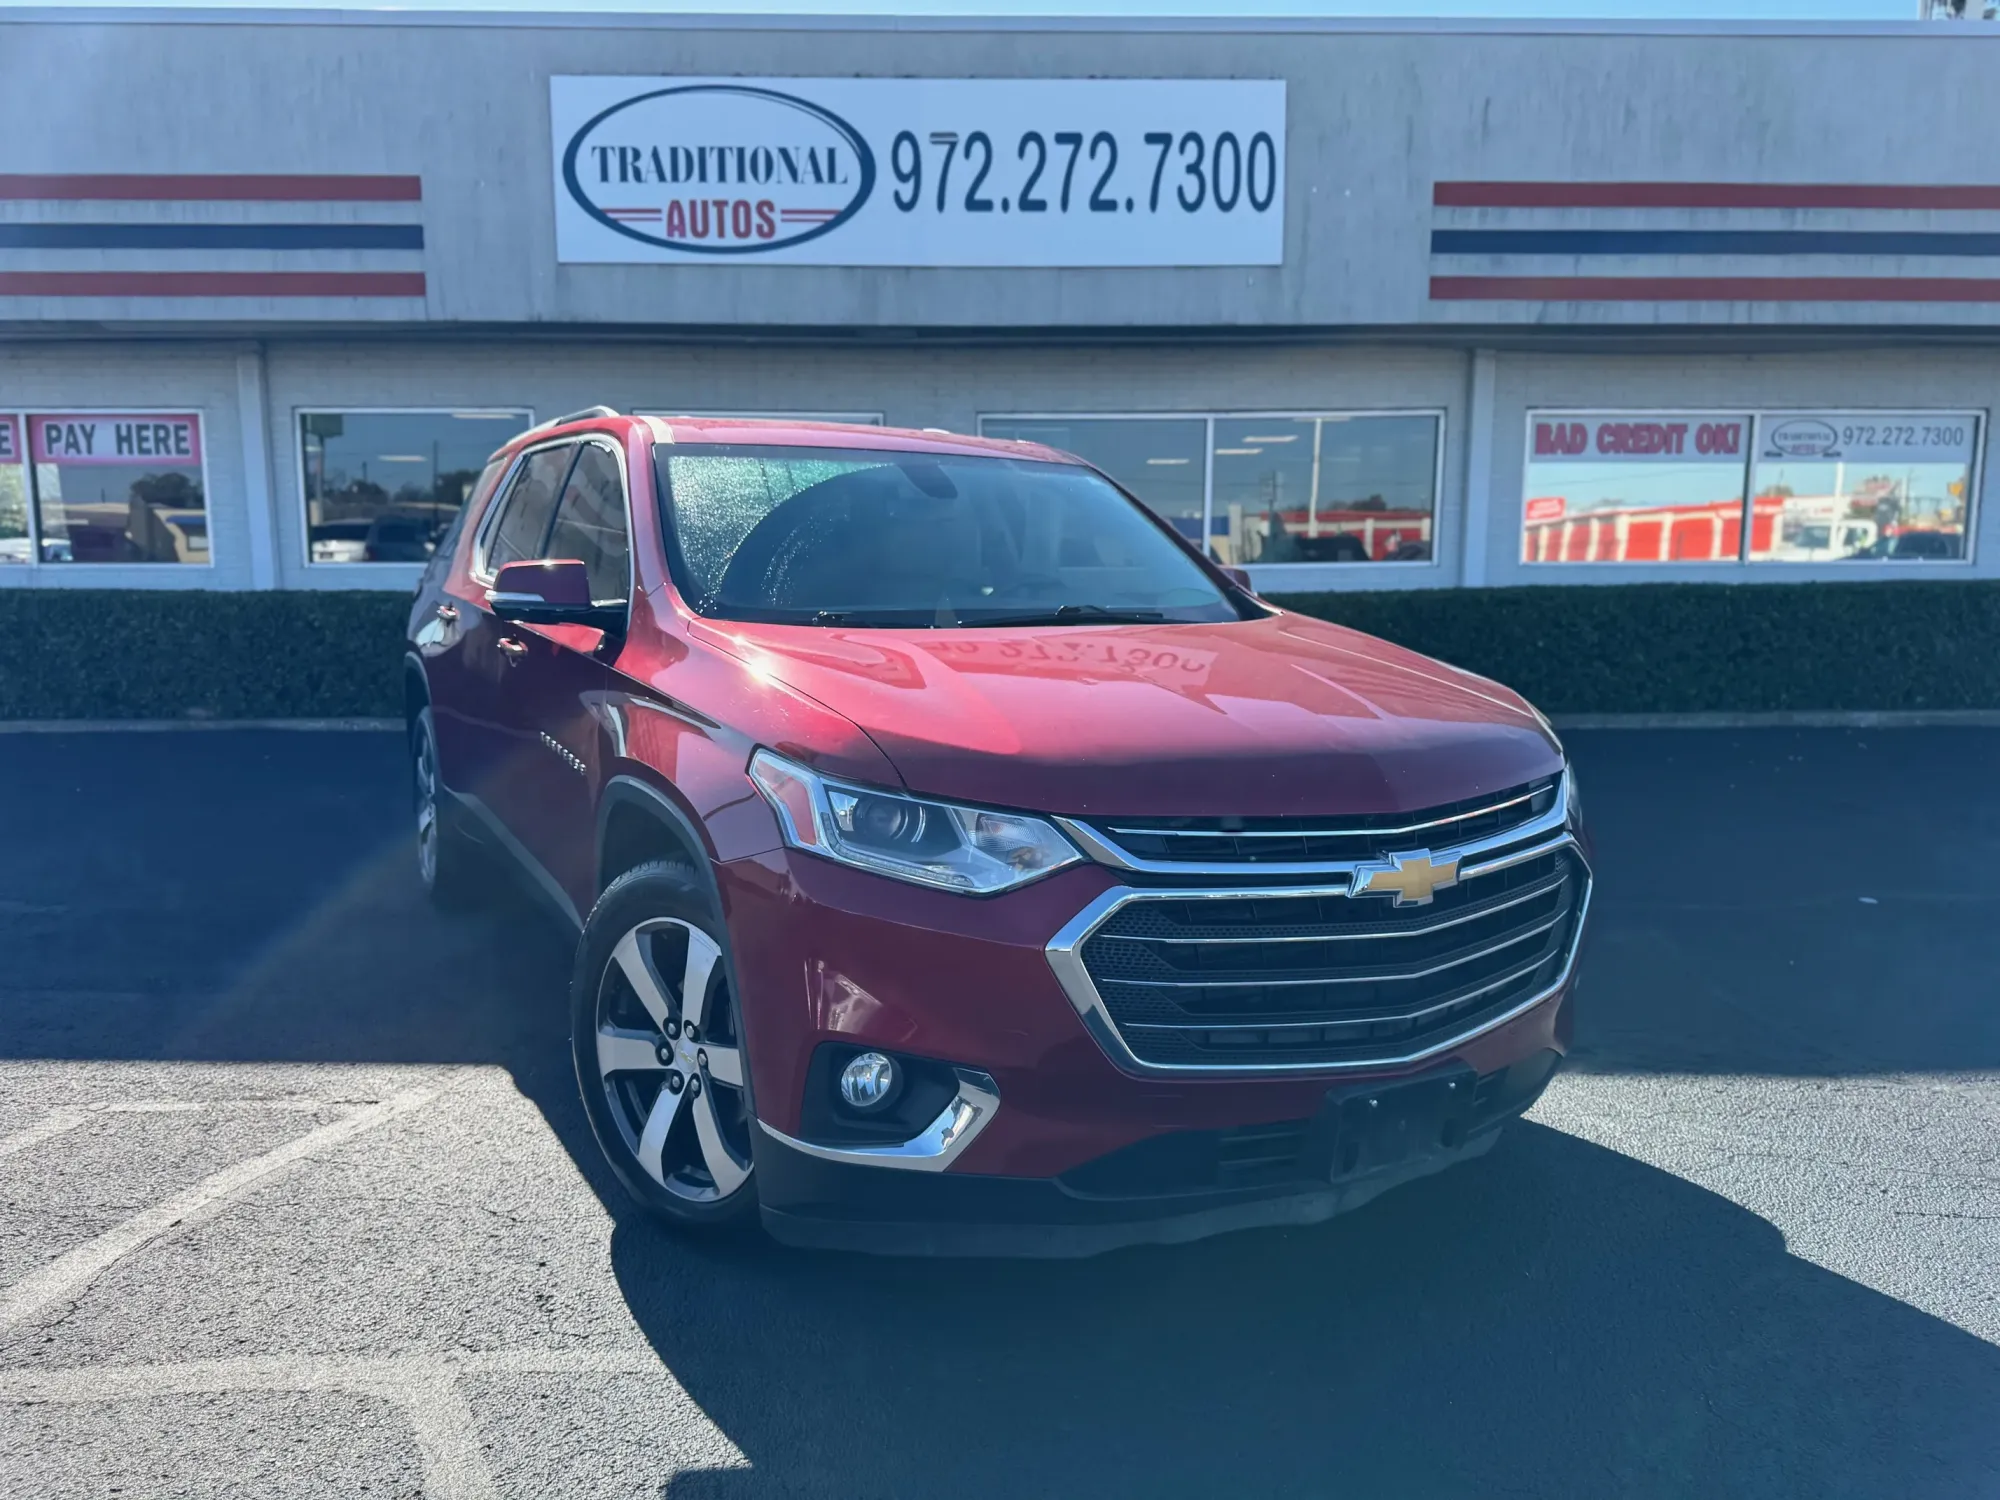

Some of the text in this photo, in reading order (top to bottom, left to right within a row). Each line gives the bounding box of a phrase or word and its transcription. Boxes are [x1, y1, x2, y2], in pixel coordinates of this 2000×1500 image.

[592, 145, 848, 184] TRADITIONAL
[891, 130, 1277, 213] 972.272.7300
[666, 198, 777, 240] AUTOS
[45, 423, 191, 456] PAY HERE
[1534, 422, 1741, 455] BAD CREDIT OK!
[1842, 426, 1964, 446] 972.272.7300
